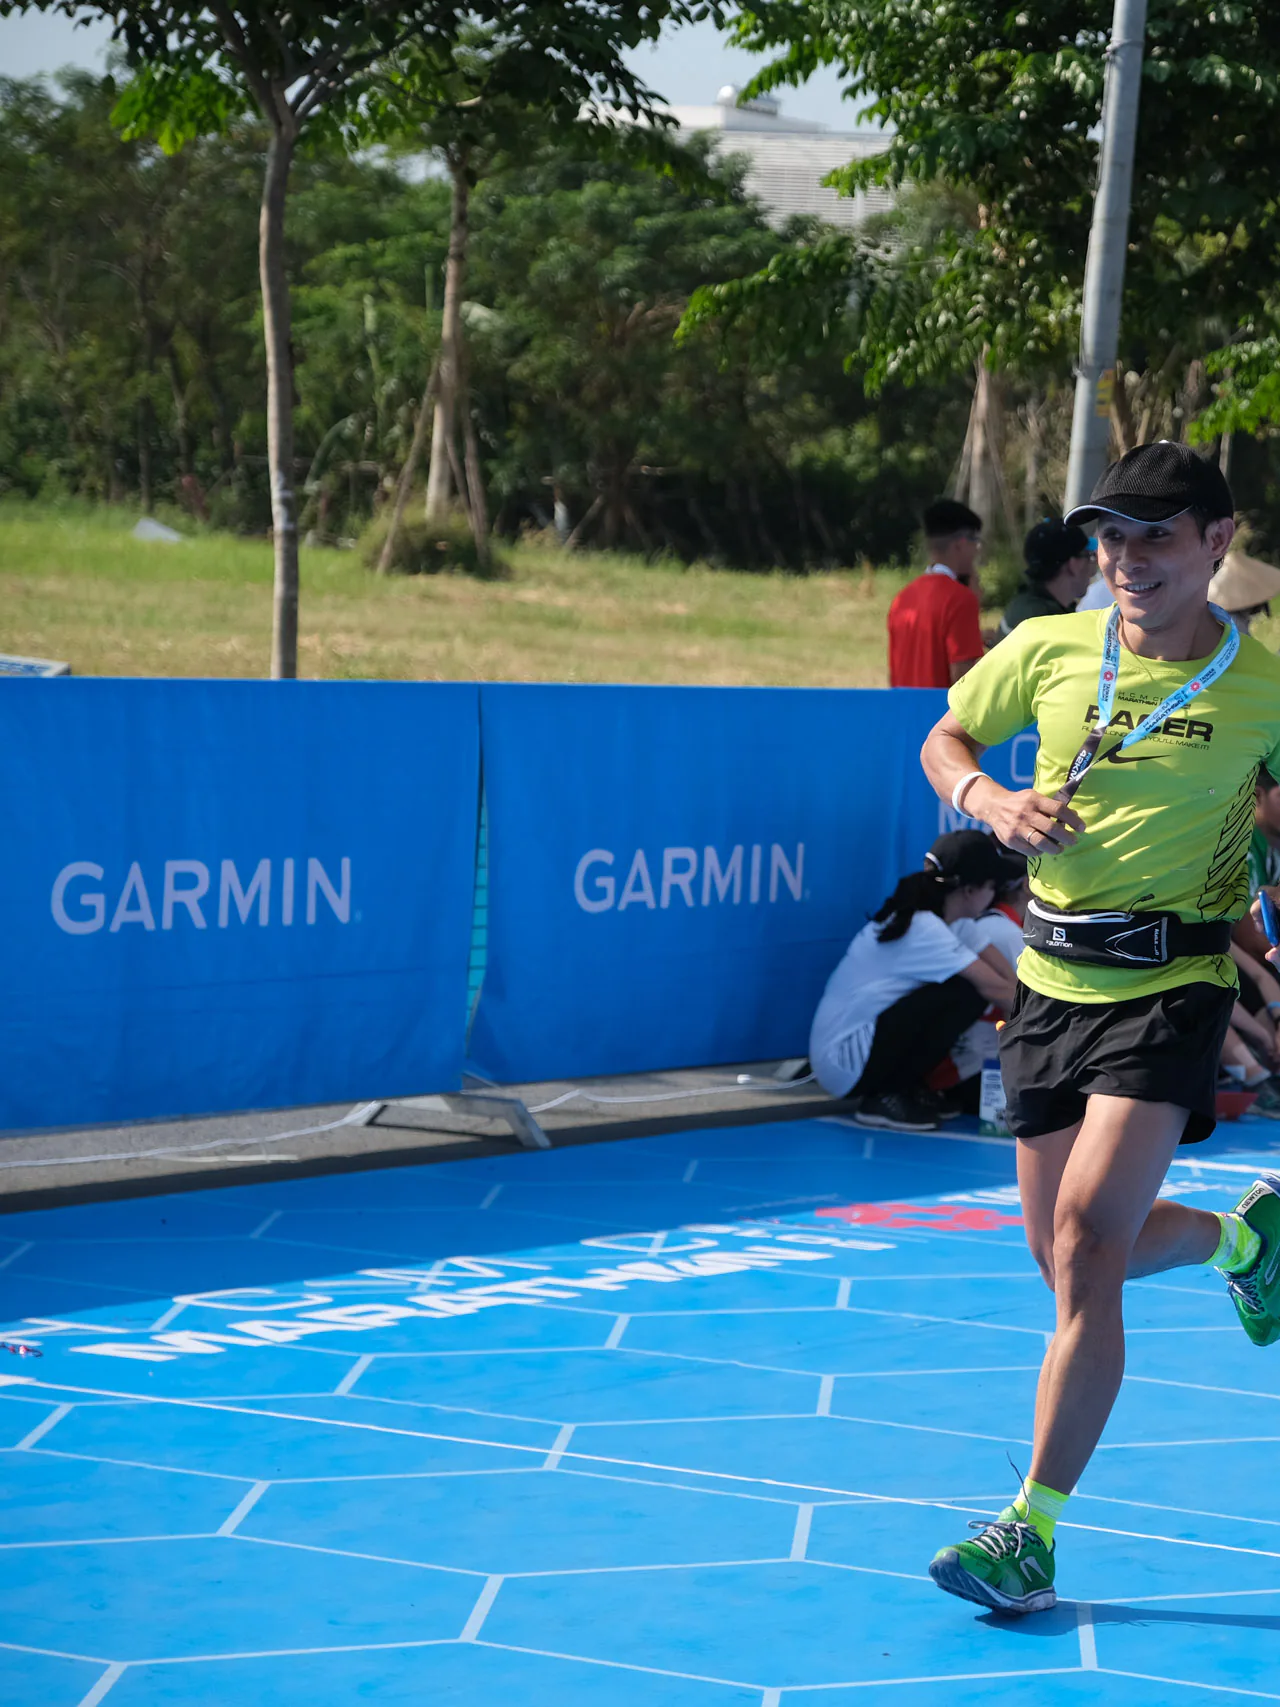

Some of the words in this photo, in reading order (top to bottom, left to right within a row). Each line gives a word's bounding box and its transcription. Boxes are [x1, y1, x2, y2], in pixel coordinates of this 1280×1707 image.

[50, 857, 352, 935] GARMIN
[573, 842, 804, 914] GARMIN
[69, 1245, 835, 1362] MARATHON
